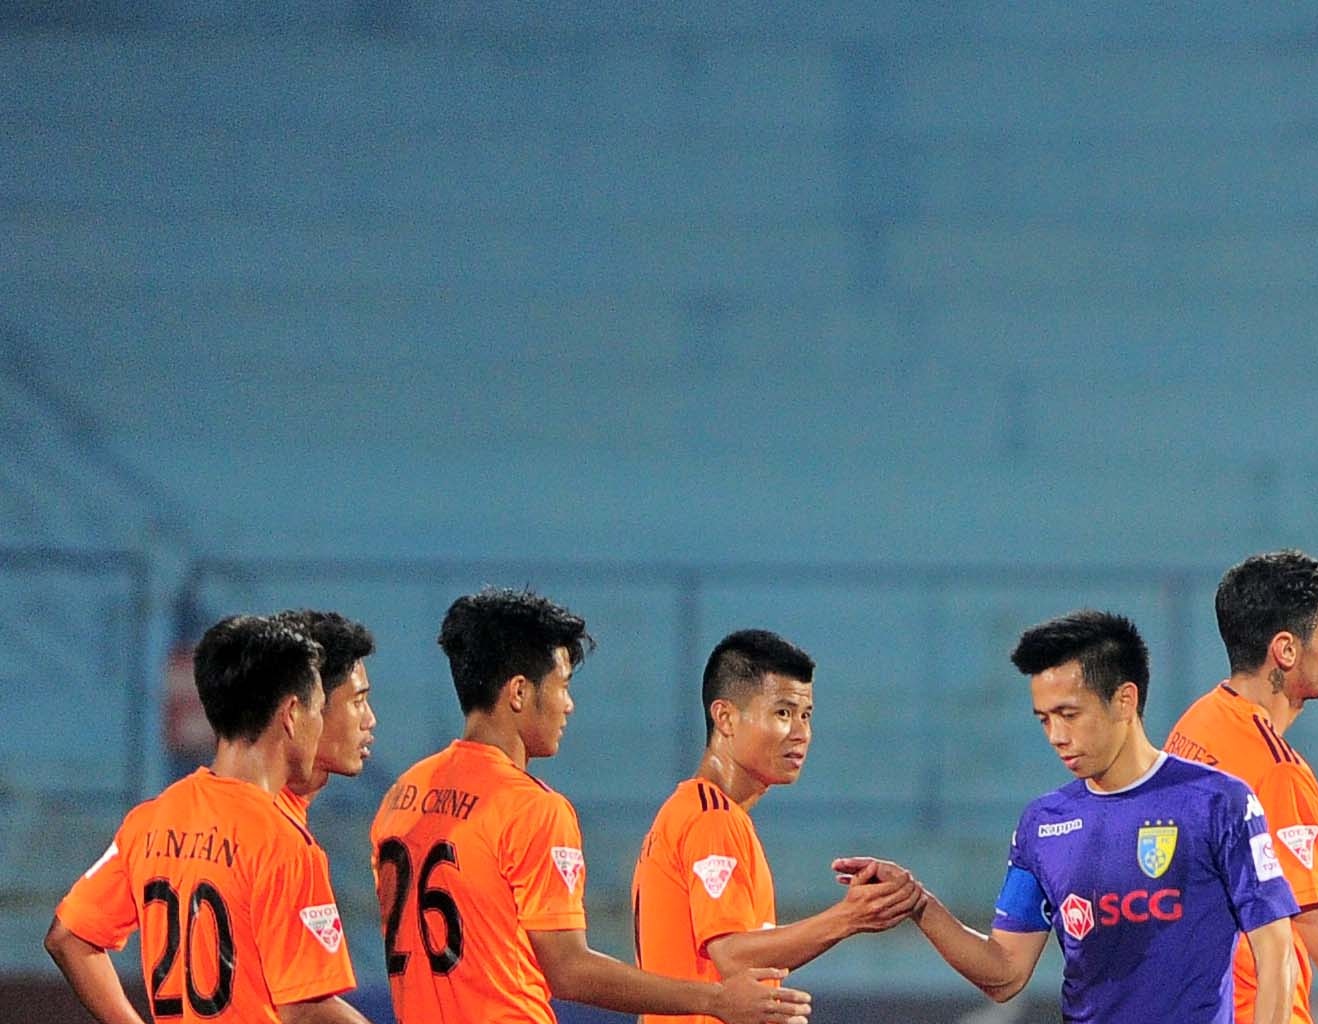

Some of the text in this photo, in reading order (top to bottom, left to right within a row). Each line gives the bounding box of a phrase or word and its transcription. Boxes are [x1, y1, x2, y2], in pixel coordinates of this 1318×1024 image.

[1038, 819, 1083, 838] Kappa
[143, 876, 236, 1018] 20
[380, 836, 464, 976] 26
[1100, 889, 1182, 926] SCG
